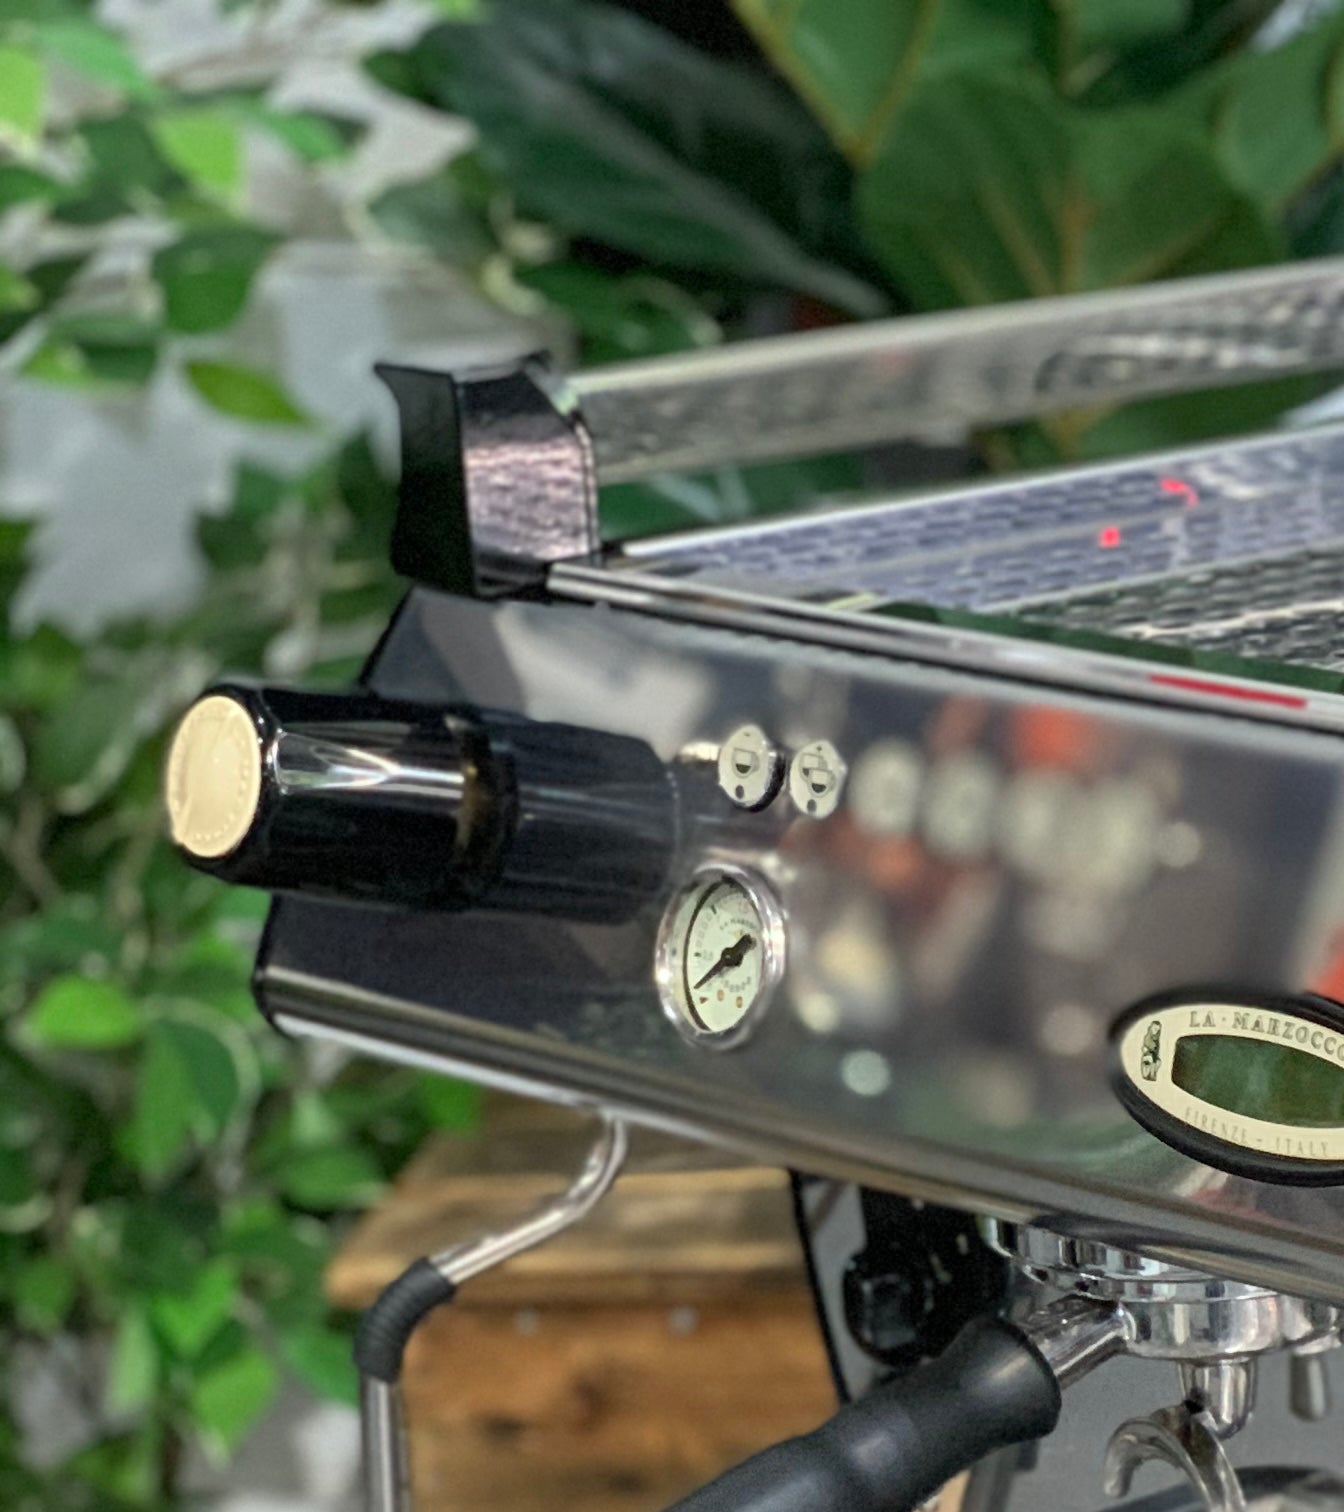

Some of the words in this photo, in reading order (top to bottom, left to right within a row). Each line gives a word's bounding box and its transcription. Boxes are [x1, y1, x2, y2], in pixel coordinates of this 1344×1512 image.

[1189, 1011, 1216, 1028] LA
[1184, 1107, 1250, 1146] FIRENZE
[1274, 1135, 1330, 1157] ITALY
